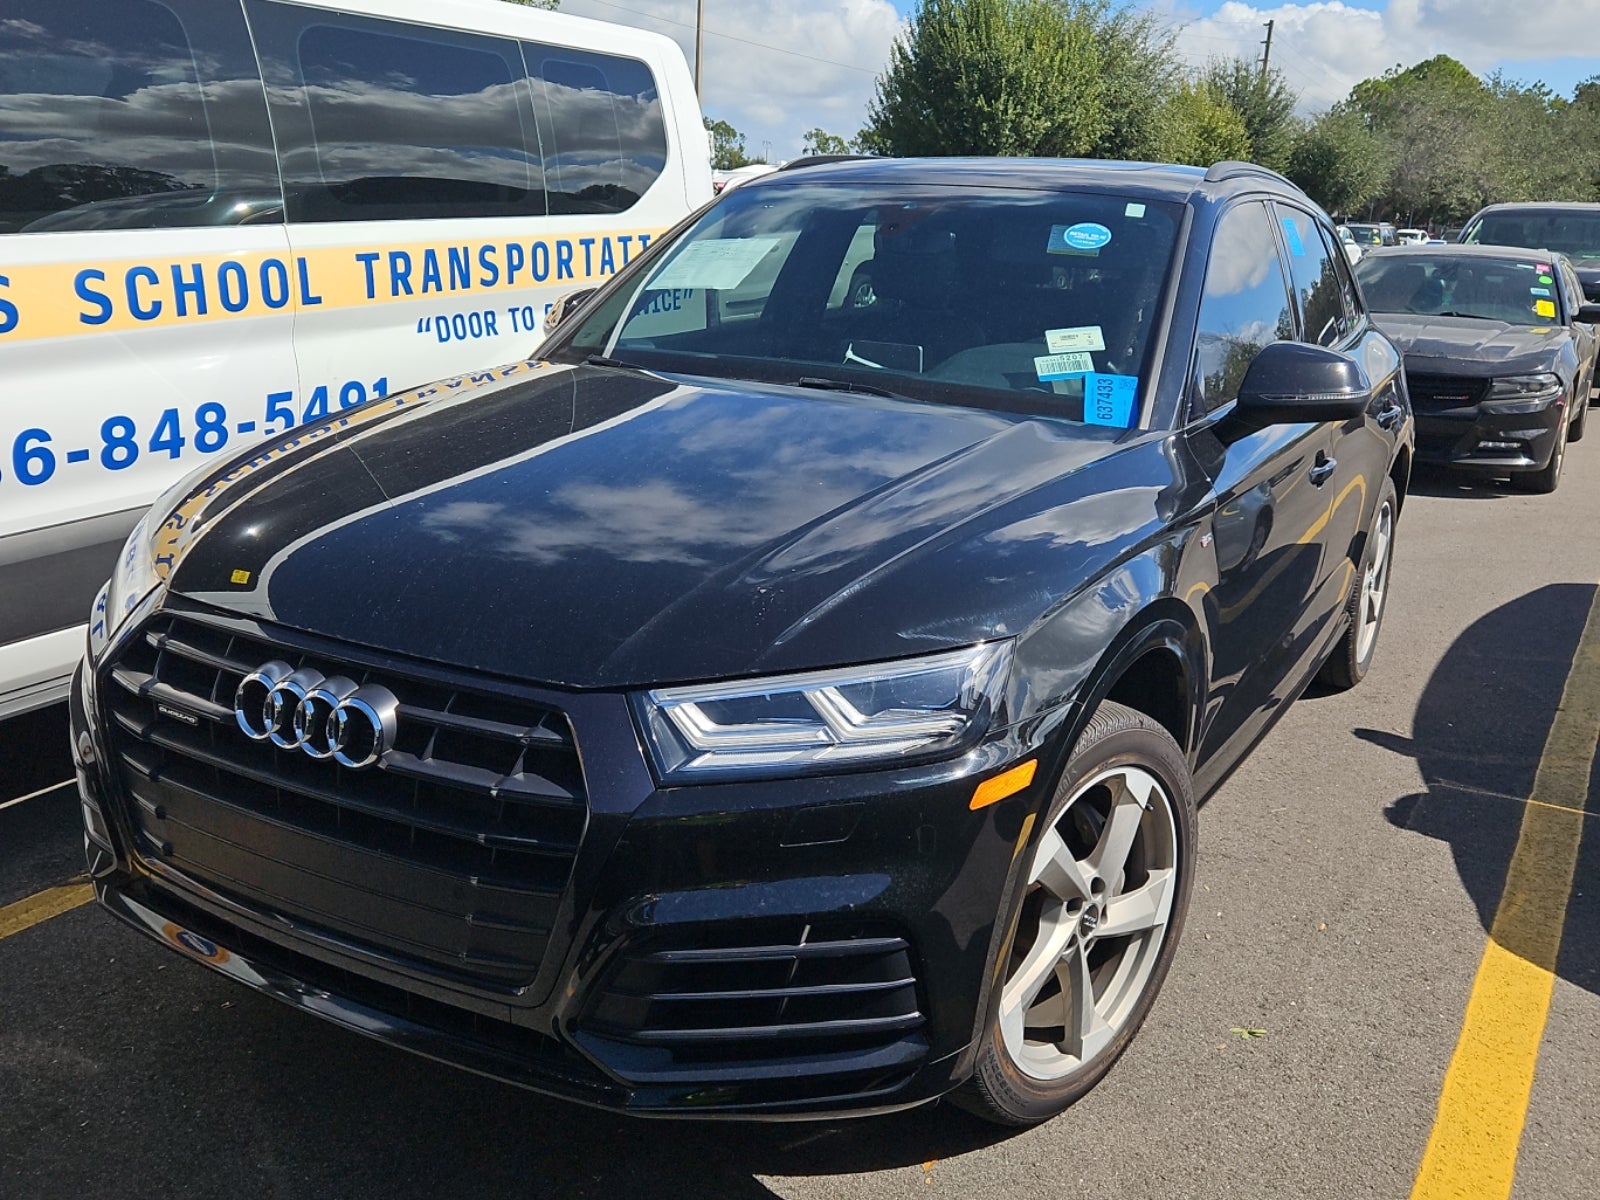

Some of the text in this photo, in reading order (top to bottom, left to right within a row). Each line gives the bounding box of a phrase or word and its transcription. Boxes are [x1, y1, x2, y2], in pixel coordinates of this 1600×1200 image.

[74, 257, 323, 325] SCHOOL
[508, 305, 535, 333] TO
[1097, 378, 1114, 421] 637433
